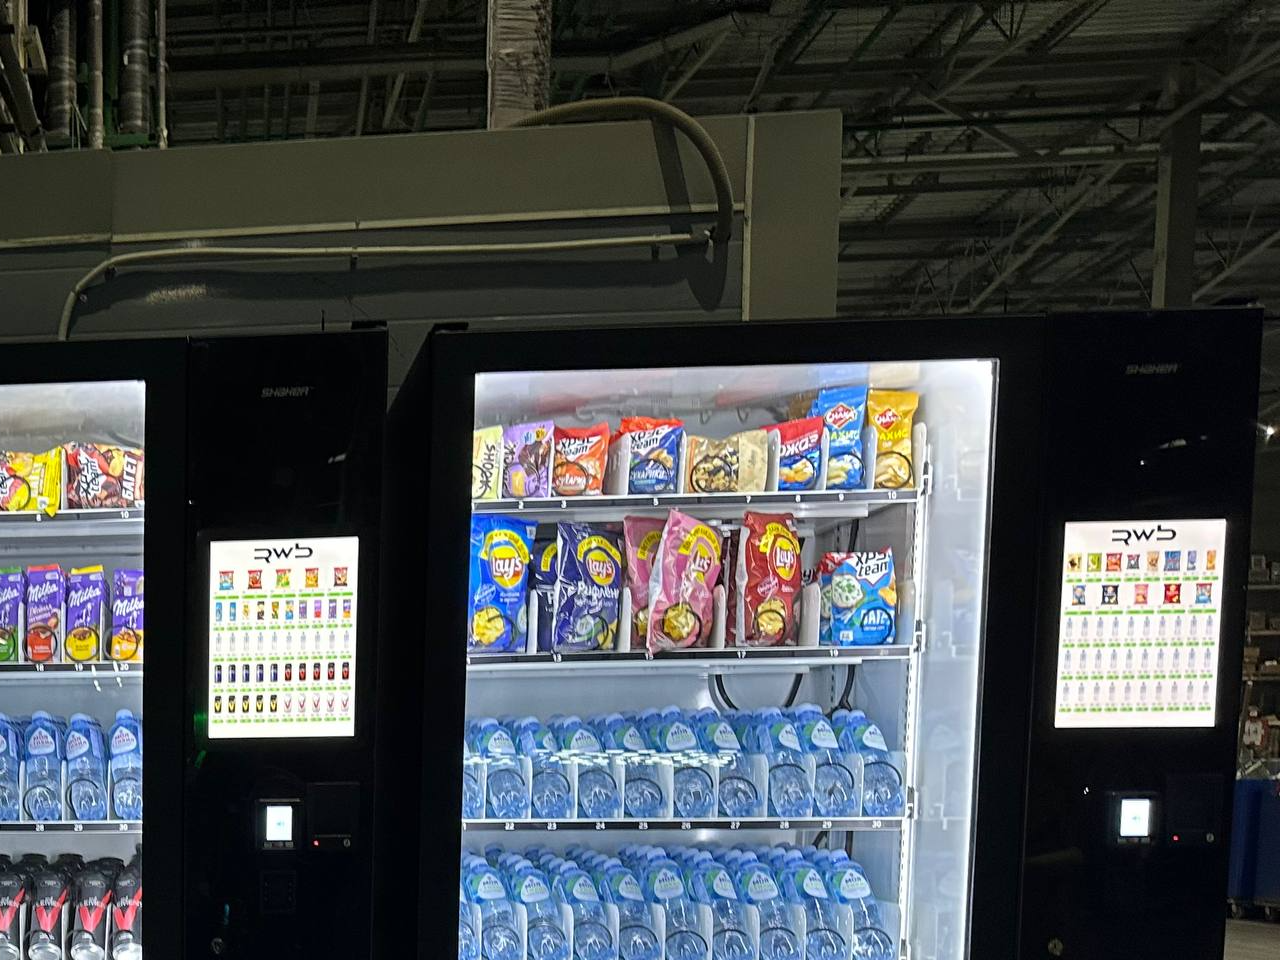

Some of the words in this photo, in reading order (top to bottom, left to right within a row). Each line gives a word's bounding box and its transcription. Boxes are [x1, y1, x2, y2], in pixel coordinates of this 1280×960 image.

[879, 431, 908, 441] АХИС
[122, 455, 138, 500] БАГЕТ
[492, 556, 522, 580] Lay's
[775, 547, 795, 569] Lay's
[588, 560, 613, 580] Lay's
[27, 581, 59, 602] Milka
[68, 585, 101, 608] Milka
[113, 596, 144, 617] Milka
